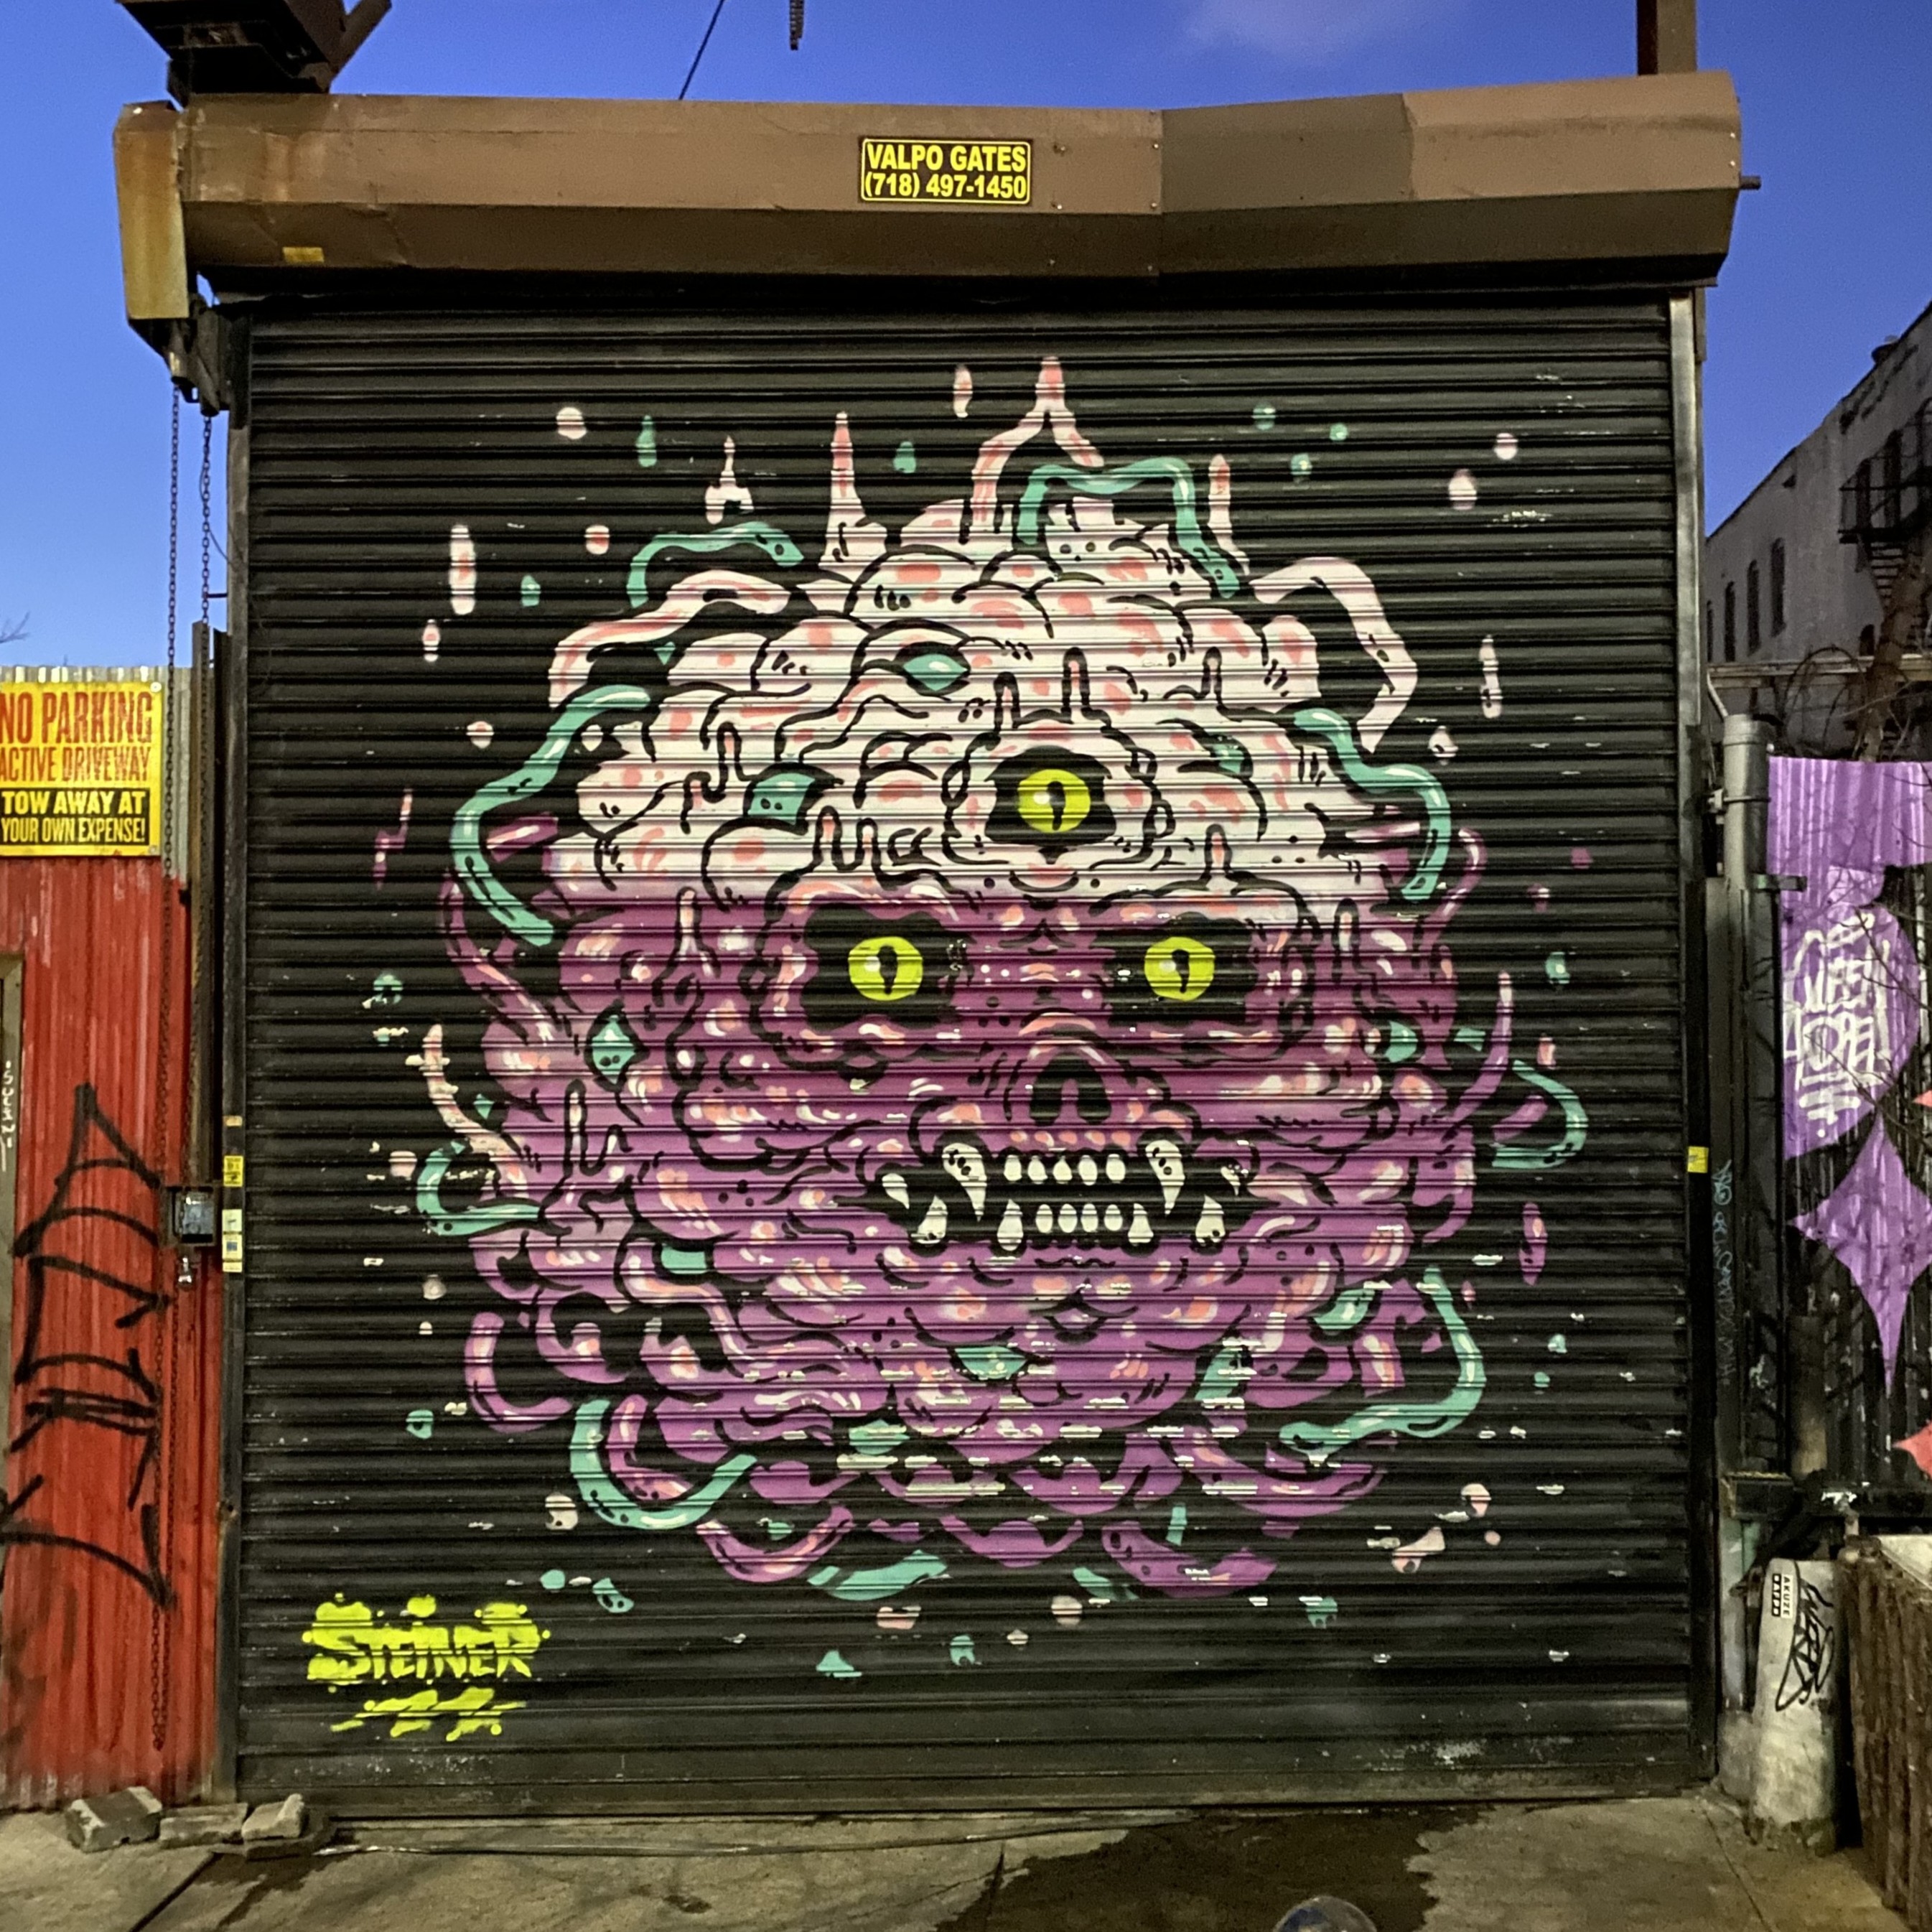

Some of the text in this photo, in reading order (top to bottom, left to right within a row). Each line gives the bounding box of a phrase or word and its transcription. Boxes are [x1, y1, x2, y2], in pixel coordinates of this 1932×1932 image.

[867, 144, 1027, 172] VALPO GATES
[865, 172, 1027, 199] (718) 497-1450
[0, 691, 153, 744] NO PARKING
[0, 747, 151, 782] ACTIVE DRIVEWAY
[1, 791, 146, 815] TOW AWAY AT
[1, 818, 146, 843] YOUR OWN EXPENSE!
